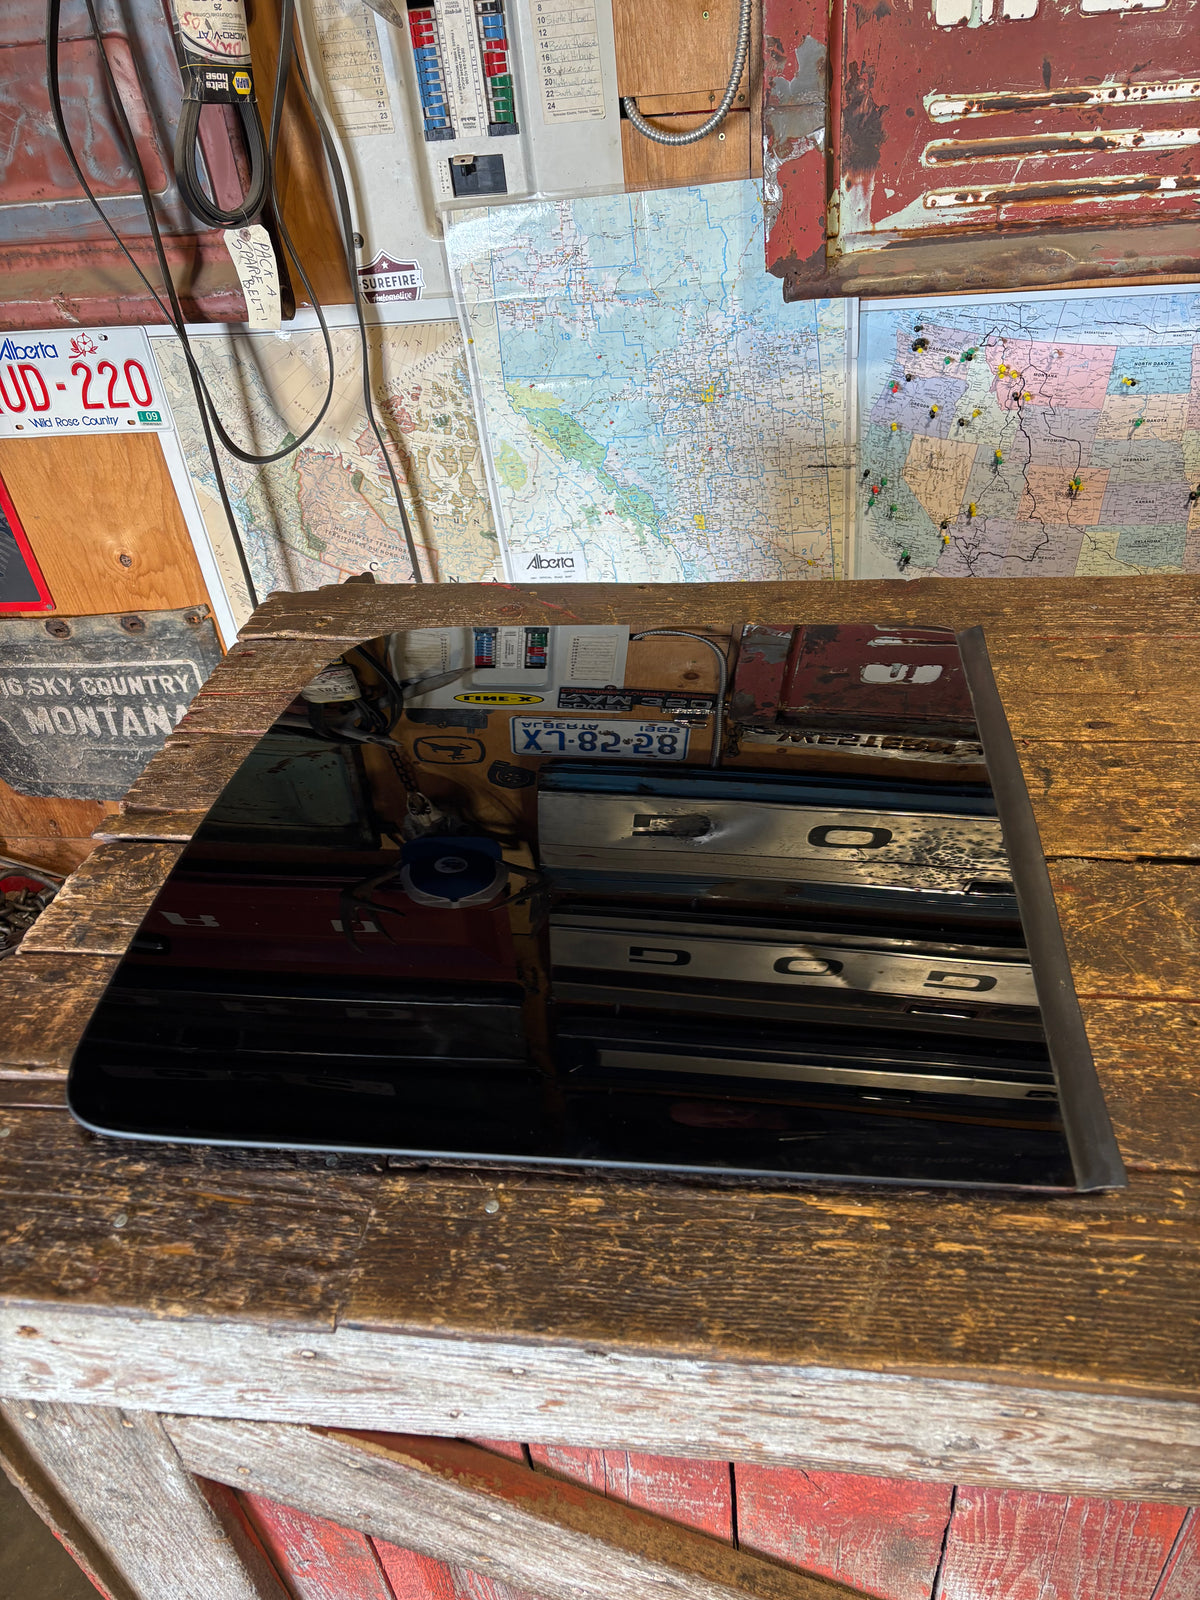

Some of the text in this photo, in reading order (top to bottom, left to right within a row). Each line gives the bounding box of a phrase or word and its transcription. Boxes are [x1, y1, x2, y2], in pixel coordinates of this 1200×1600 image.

[537, 4, 542, 12] 8
[537, 16, 546, 24] 10
[538, 29, 547, 37] 12
[540, 41, 549, 49] 14
[205, 72, 228, 80] hose
[205, 80, 229, 91] belts
[235, 77, 250, 89] NAPA
[544, 78, 553, 86] 20
[545, 90, 554, 98] 22
[547, 102, 556, 110] 24
[379, 112, 388, 120] 23
[231, 238, 264, 285] SPARE
[253, 241, 277, 297] PACK A
[361, 274, 417, 290] SUREFIRE
[560, 333, 571, 341] 13
[0, 338, 59, 360] Alberta
[928, 346, 960, 355] WASHINGTON
[0, 359, 153, 414] UD-220
[145, 412, 158, 421] 09
[28, 415, 119, 428] Wild Rose Country
[526, 553, 575, 570] Alberta
[0, 674, 189, 697] IG SKY COUNTRY
